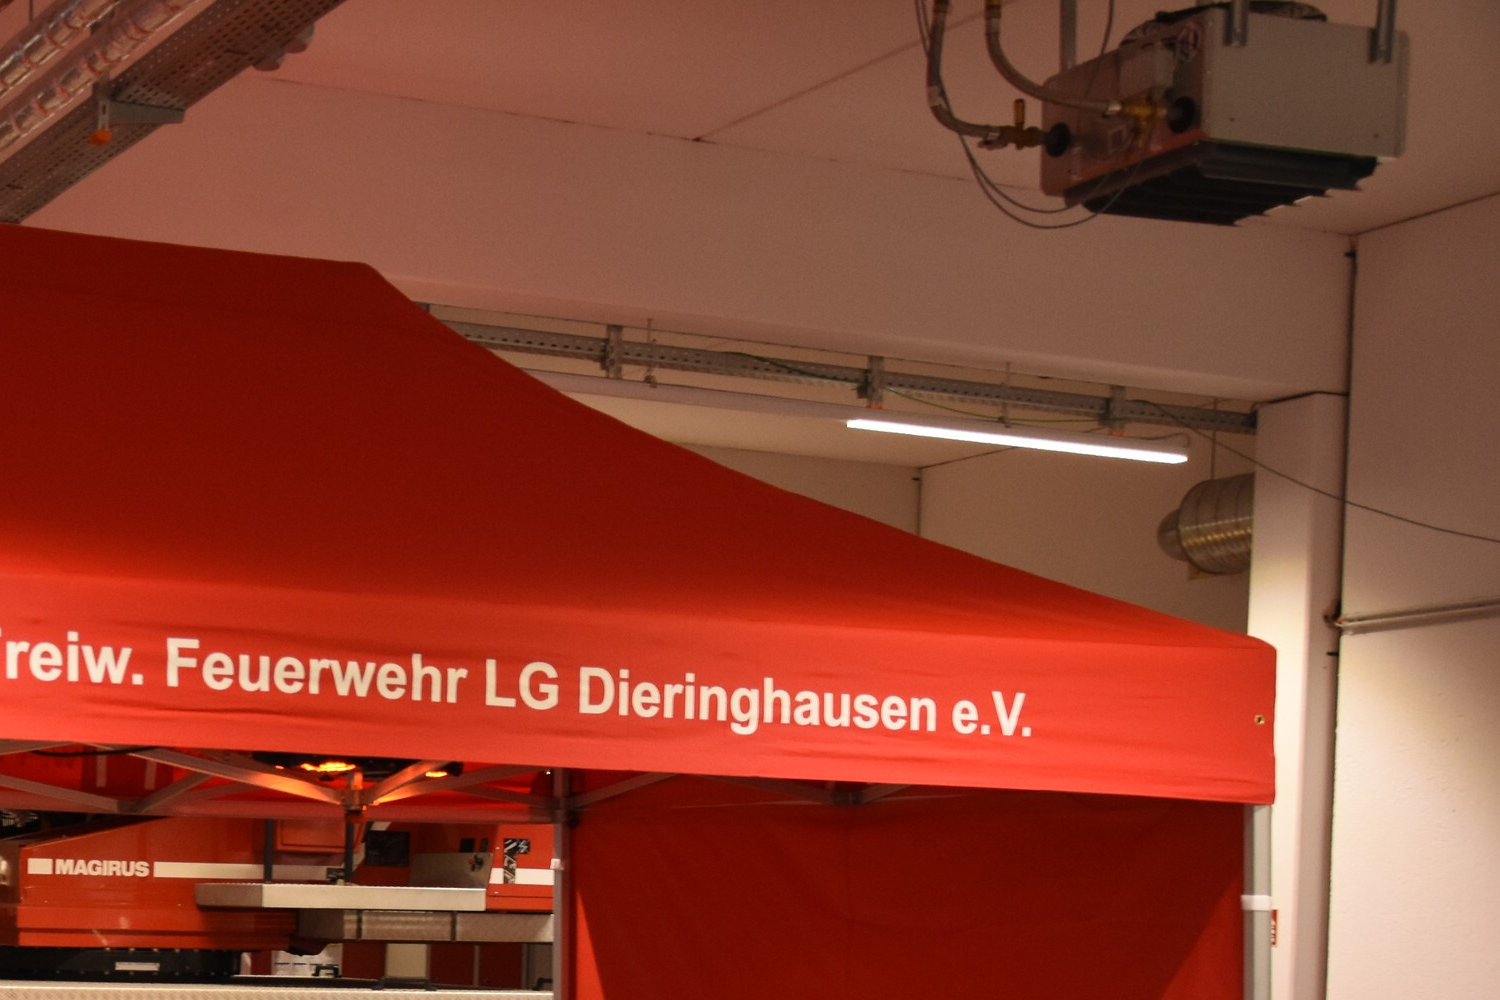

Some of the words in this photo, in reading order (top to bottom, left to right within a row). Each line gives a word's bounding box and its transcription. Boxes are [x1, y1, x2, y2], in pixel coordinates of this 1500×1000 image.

[166, 638, 468, 703] Feuerwehr
[486, 659, 558, 710] LG
[579, 667, 937, 735] Dieringhausen
[952, 691, 1032, 737] e.V.
[55, 858, 149, 878] MAGIRUS
